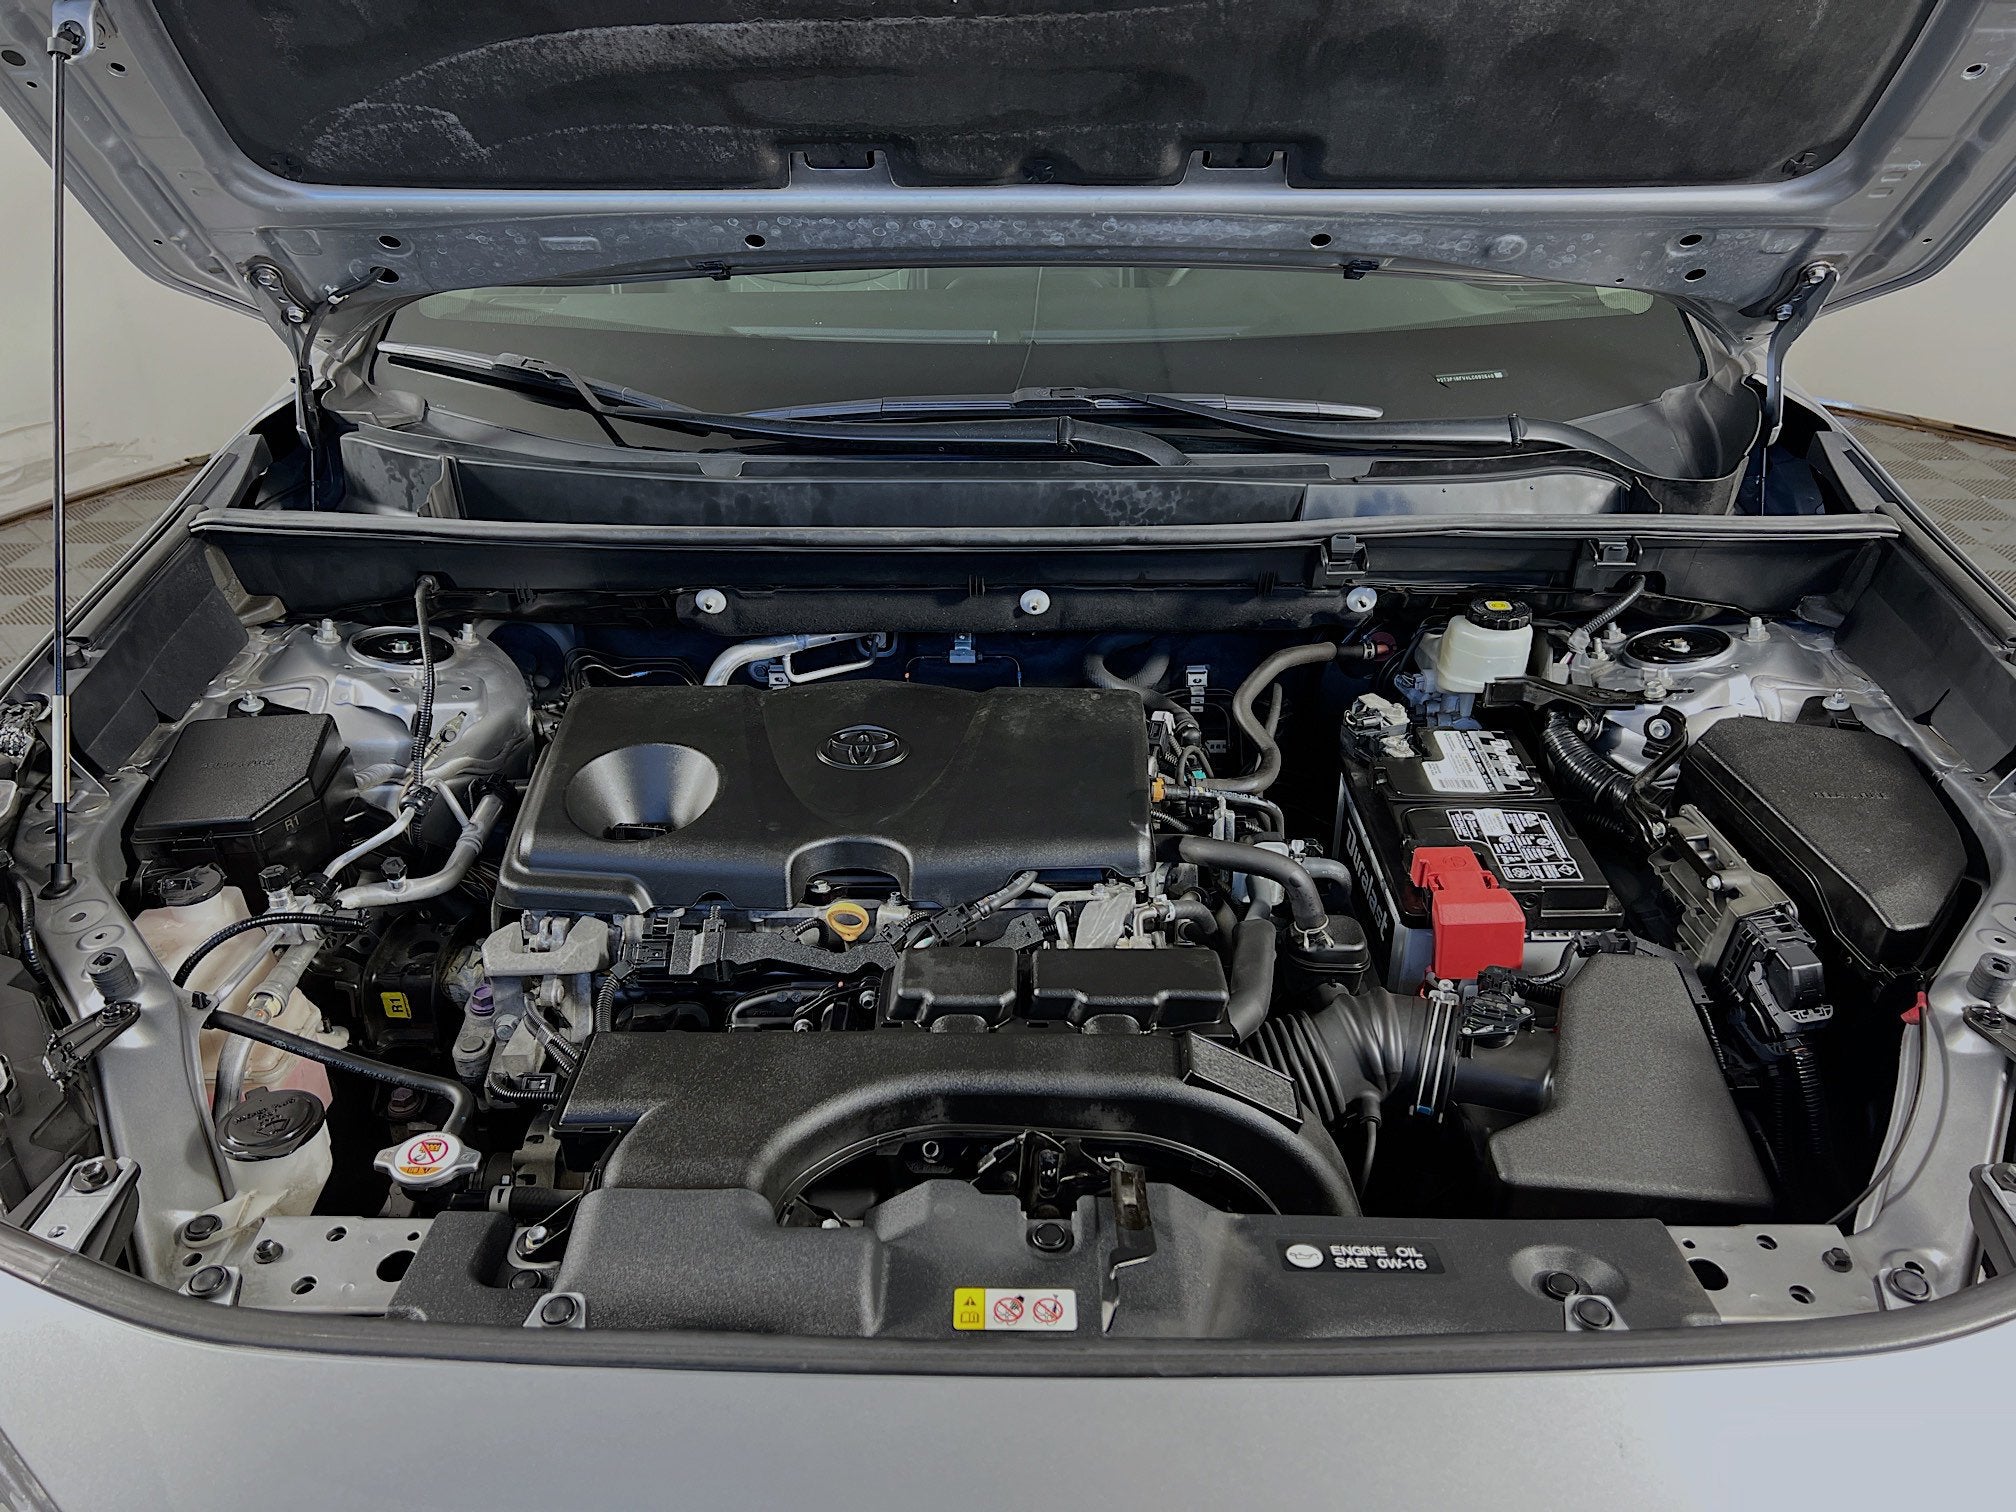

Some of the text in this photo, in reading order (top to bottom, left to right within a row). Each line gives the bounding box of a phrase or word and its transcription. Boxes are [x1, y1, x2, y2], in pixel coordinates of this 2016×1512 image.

[284, 815, 299, 831] R1
[1346, 818, 1388, 941] Duralast
[390, 999, 404, 1012] R1
[1329, 1245, 1424, 1258] ENGINE OIL
[1334, 1257, 1428, 1270] SAE 0W-16
